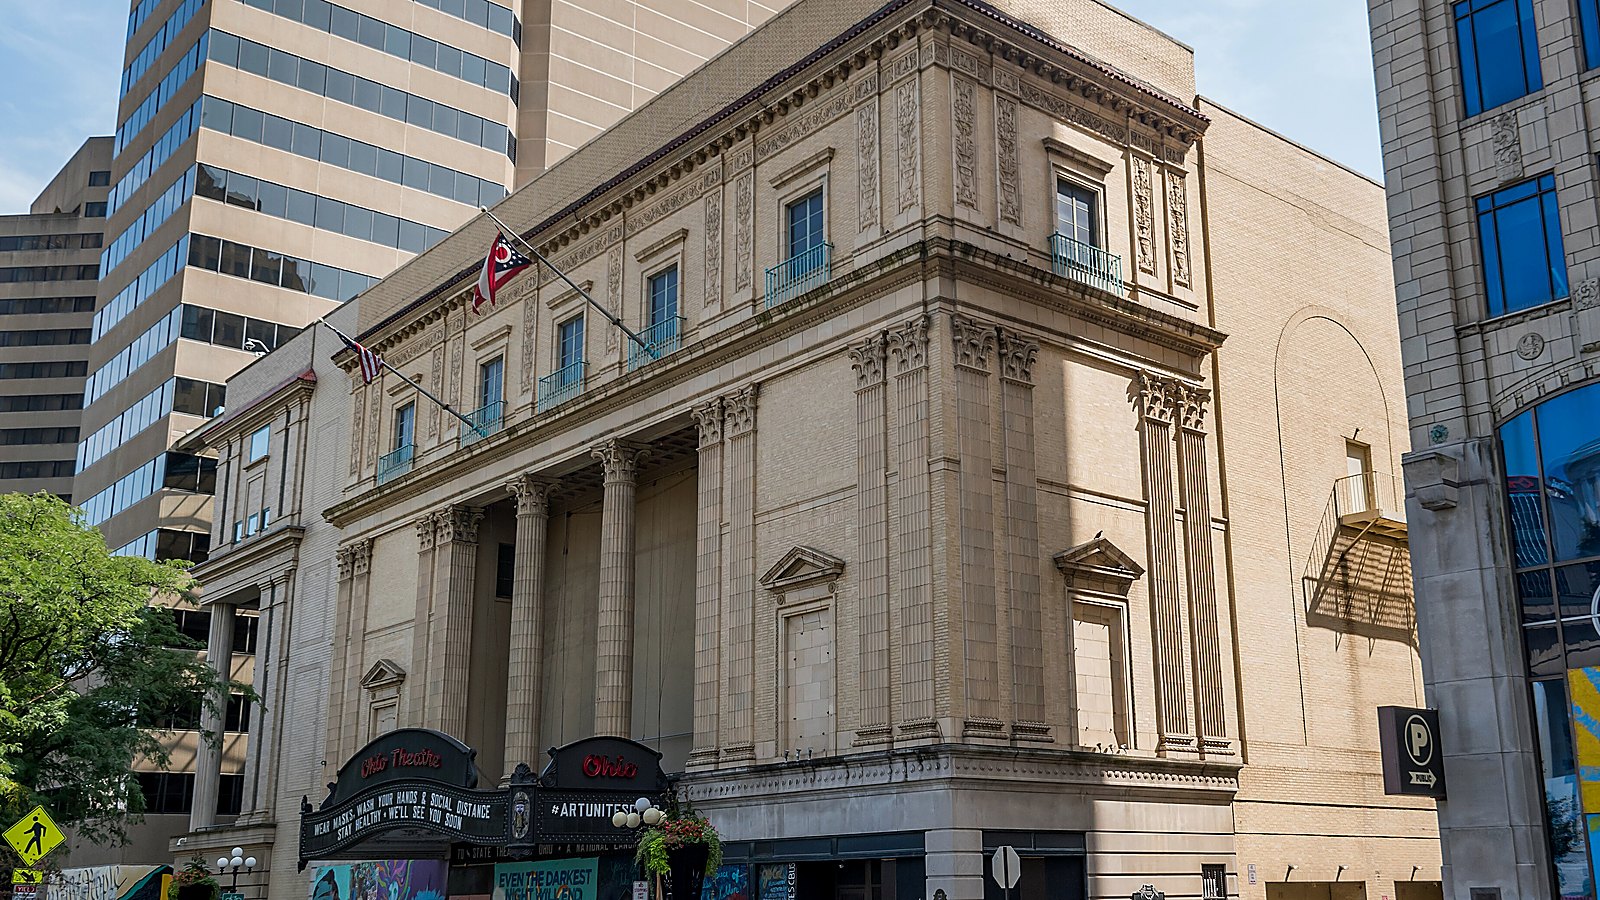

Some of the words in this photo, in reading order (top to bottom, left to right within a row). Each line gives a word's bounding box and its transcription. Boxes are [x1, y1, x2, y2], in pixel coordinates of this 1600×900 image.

[1410, 723, 1428, 756] P
[361, 753, 389, 779] Ohio
[391, 747, 442, 768] Theatre
[583, 754, 638, 777] Ohio
[1415, 774, 1432, 782] PUBLIC
[314, 820, 331, 836] WEAR
[356, 797, 375, 816] WASH
[378, 792, 394, 808] YOUR
[397, 790, 418, 804] HANDS
[421, 791, 427, 805] &
[430, 792, 453, 812] SOCIAL
[456, 800, 491, 819] DISTANCE
[337, 822, 353, 841] STAY
[355, 809, 381, 832] HEALTHY
[388, 805, 409, 819] WE'LL
[412, 805, 426, 819] SEE
[429, 807, 442, 824] YOU
[444, 812, 462, 830] SOON
[472, 846, 492, 859] STATE
[499, 872, 525, 887] EVEN
[525, 871, 544, 887] THE
[545, 869, 592, 886] DARKEST
[504, 887, 533, 900] NIGHT
[535, 887, 557, 900] WILL
[562, 887, 583, 900] END
